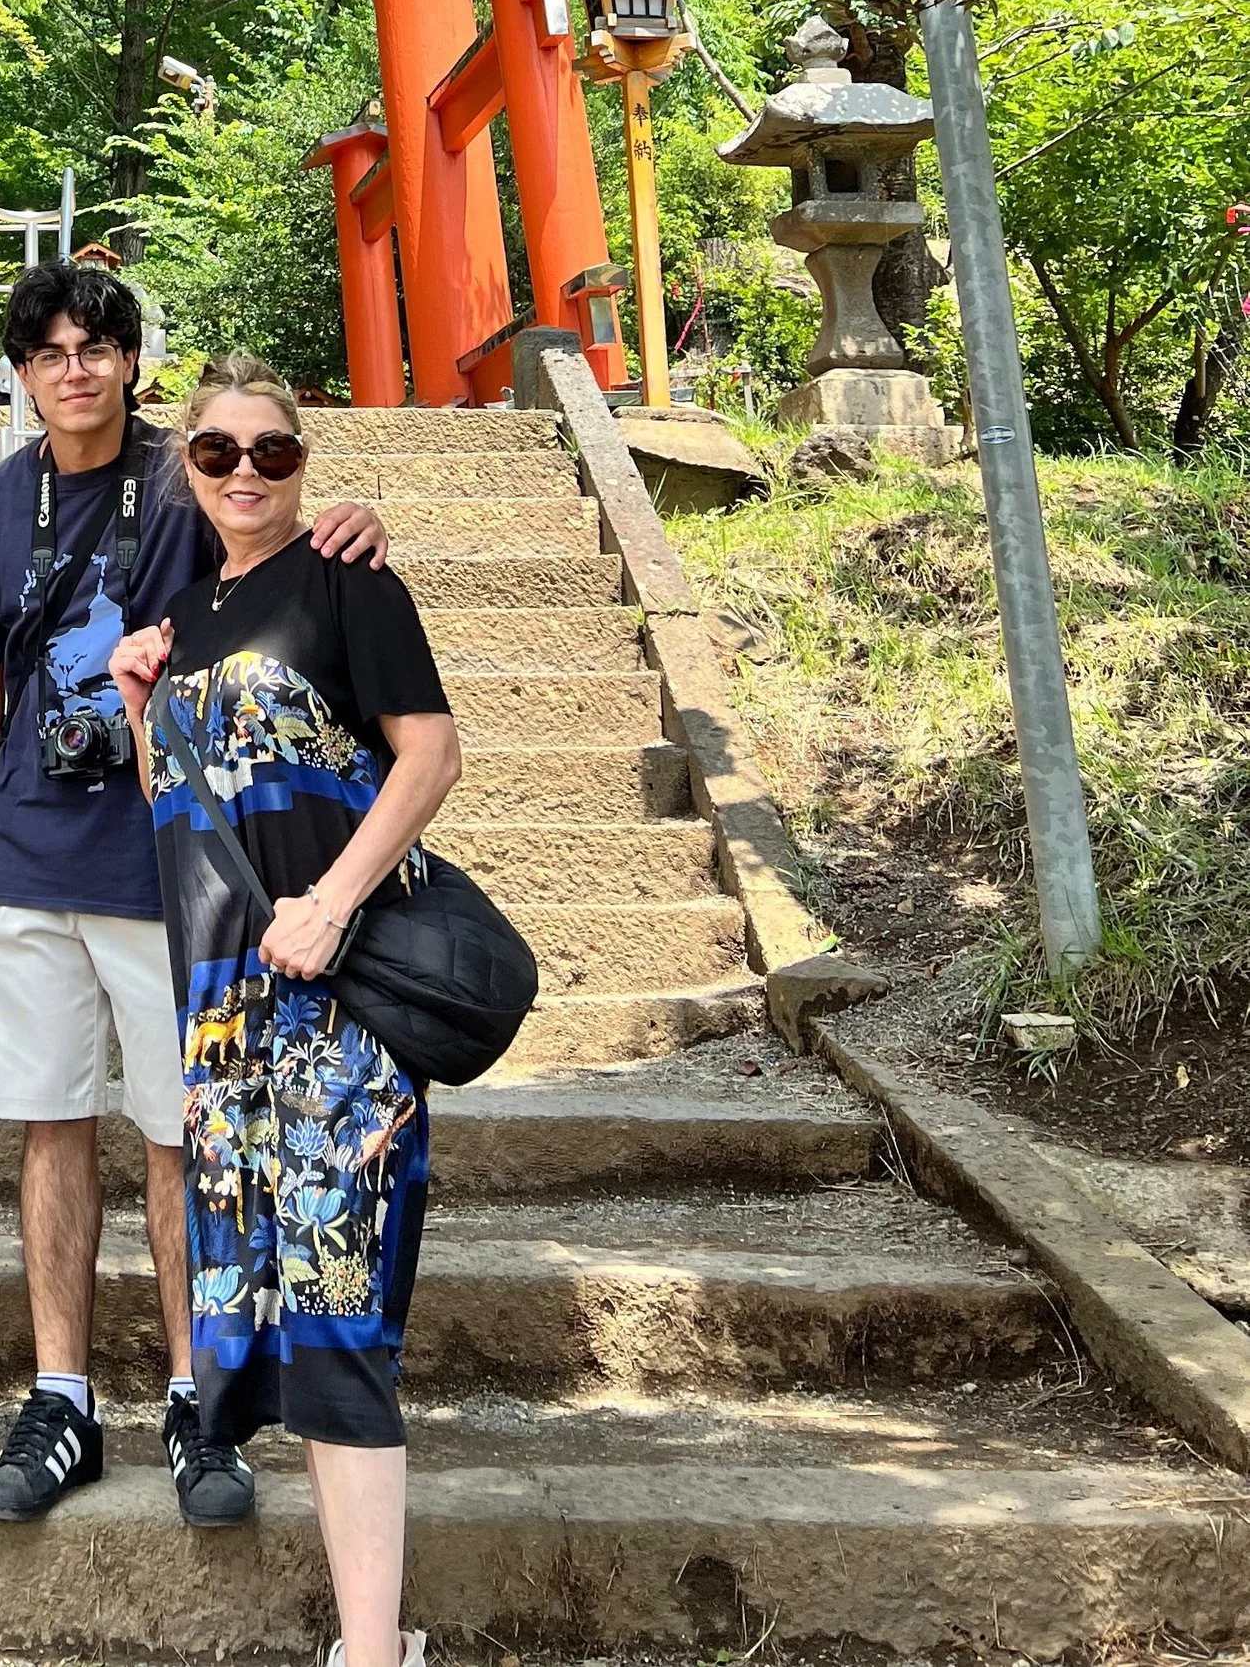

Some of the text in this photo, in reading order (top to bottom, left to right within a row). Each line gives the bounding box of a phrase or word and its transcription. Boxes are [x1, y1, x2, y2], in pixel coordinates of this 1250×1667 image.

[633, 103, 652, 161] 奉納
[38, 472, 50, 528] Canon
[122, 478, 137, 518] EOS
